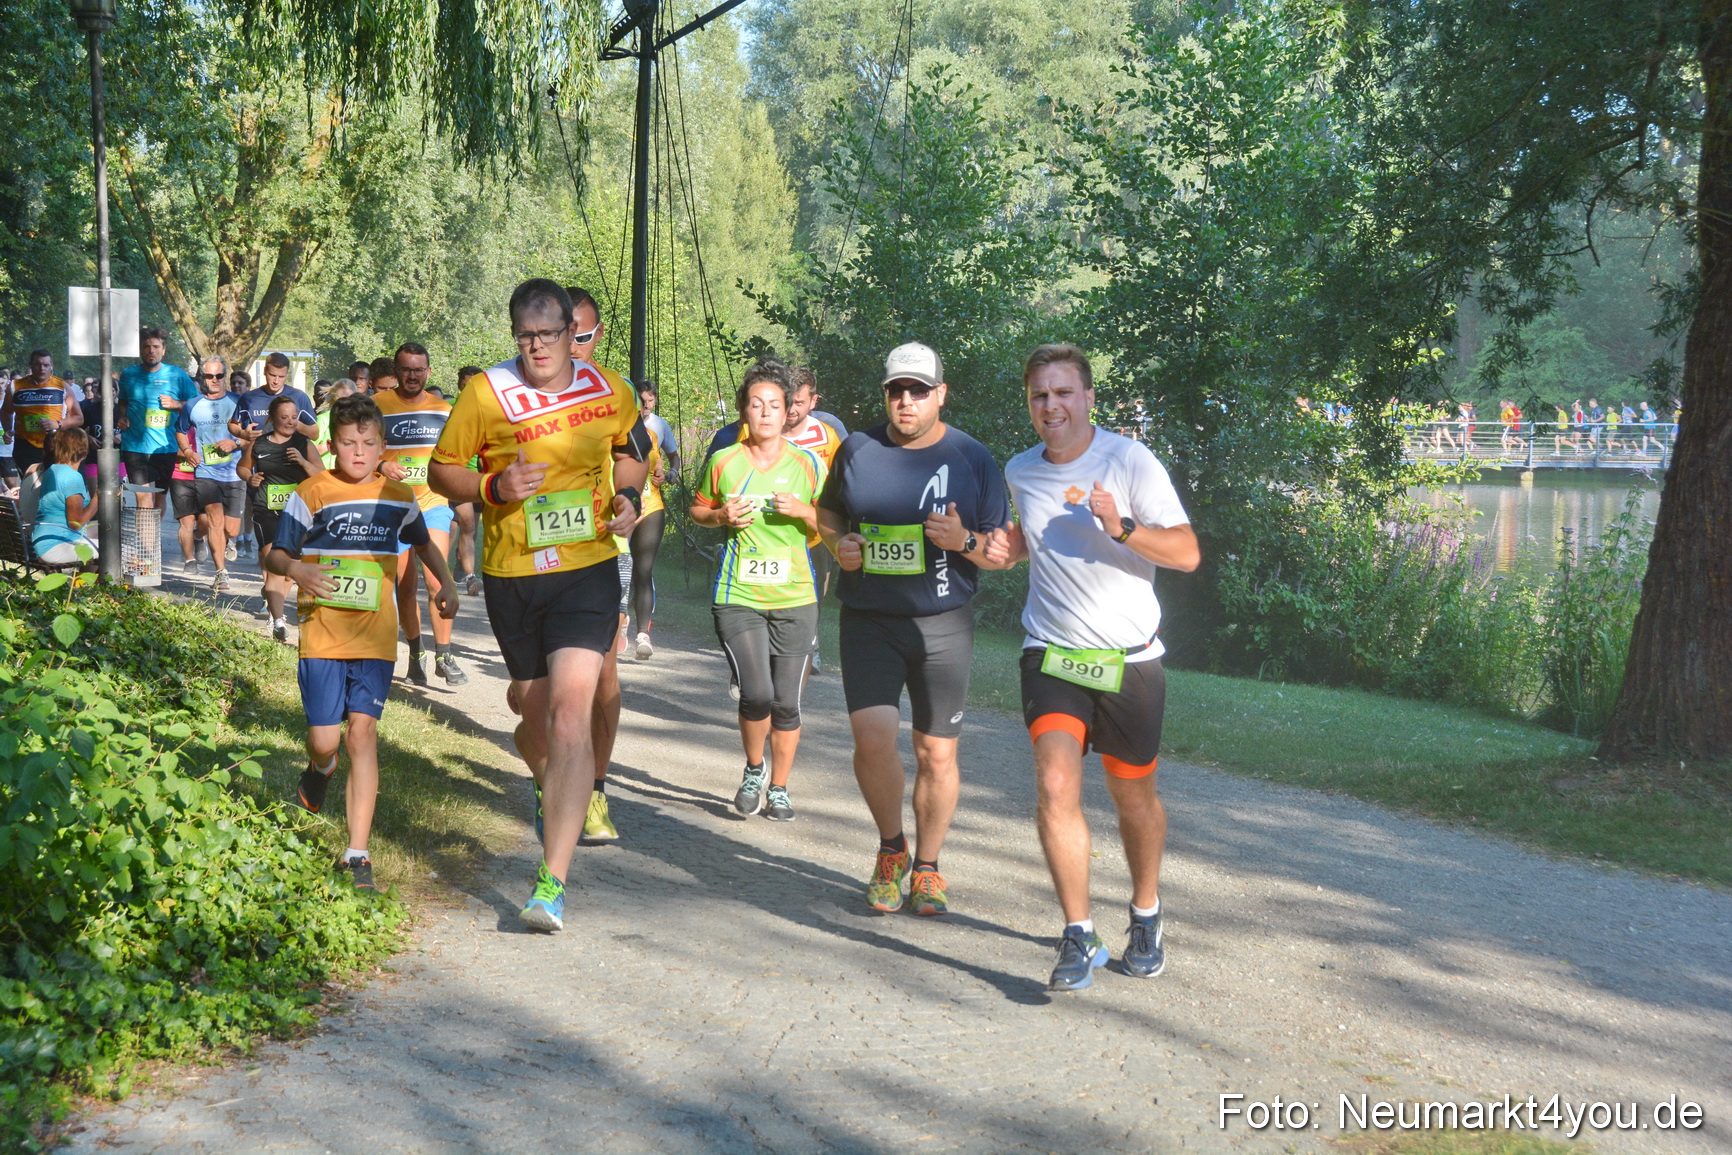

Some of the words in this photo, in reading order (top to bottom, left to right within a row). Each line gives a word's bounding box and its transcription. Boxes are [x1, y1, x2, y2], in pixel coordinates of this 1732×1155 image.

[401, 425, 440, 435] Fischer
[513, 419, 563, 444] MAX
[567, 403, 618, 428] BÖGL
[405, 466, 427, 478] 578
[535, 507, 586, 531] 1214
[337, 523, 391, 536] Fischer
[868, 541, 915, 561] 1595
[749, 560, 779, 576] 213
[331, 575, 367, 595] 579
[1061, 657, 1104, 679] 990
